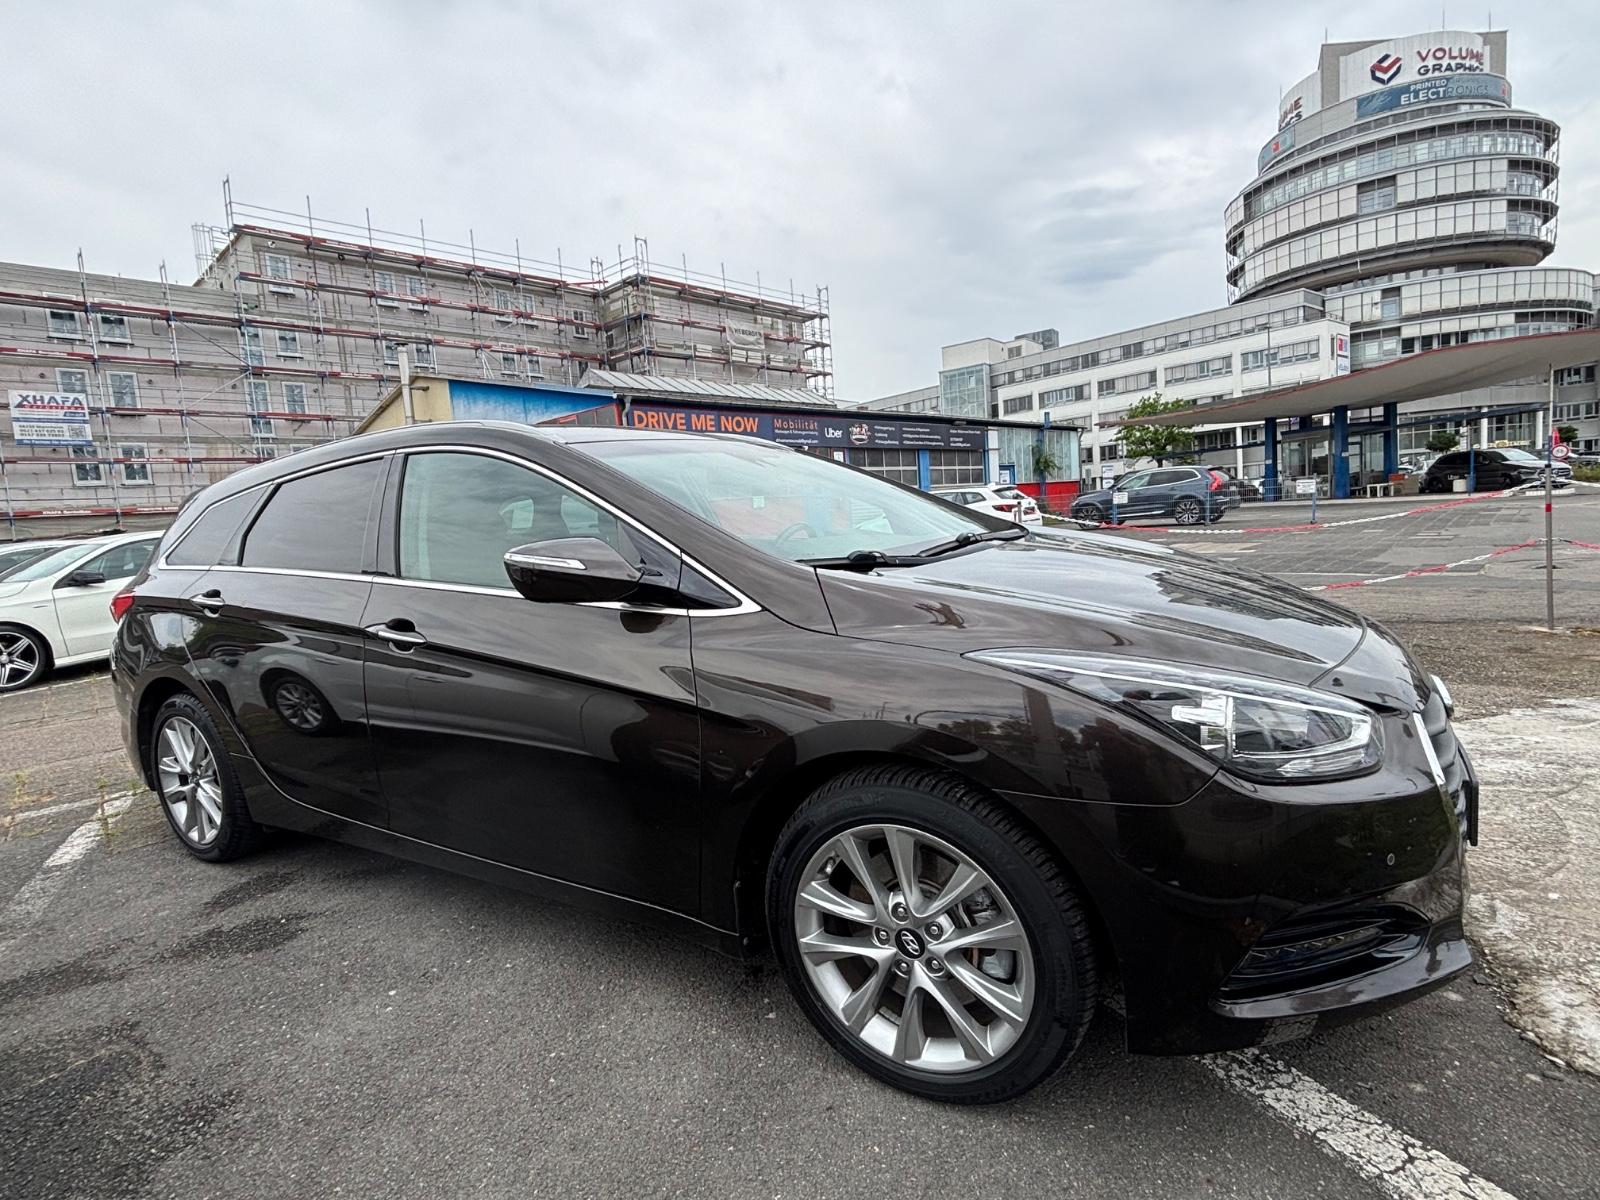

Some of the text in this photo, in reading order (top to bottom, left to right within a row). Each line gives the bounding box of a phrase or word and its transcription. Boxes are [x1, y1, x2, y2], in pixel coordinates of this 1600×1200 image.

[1410, 80, 1447, 92] PRINTED
[1400, 85, 1489, 106] ELECTRONICS
[15, 395, 84, 408] XHAFA
[633, 410, 759, 432] DRIVE ME NOW
[774, 418, 818, 430] Mobilität
[824, 427, 843, 438] Uber
